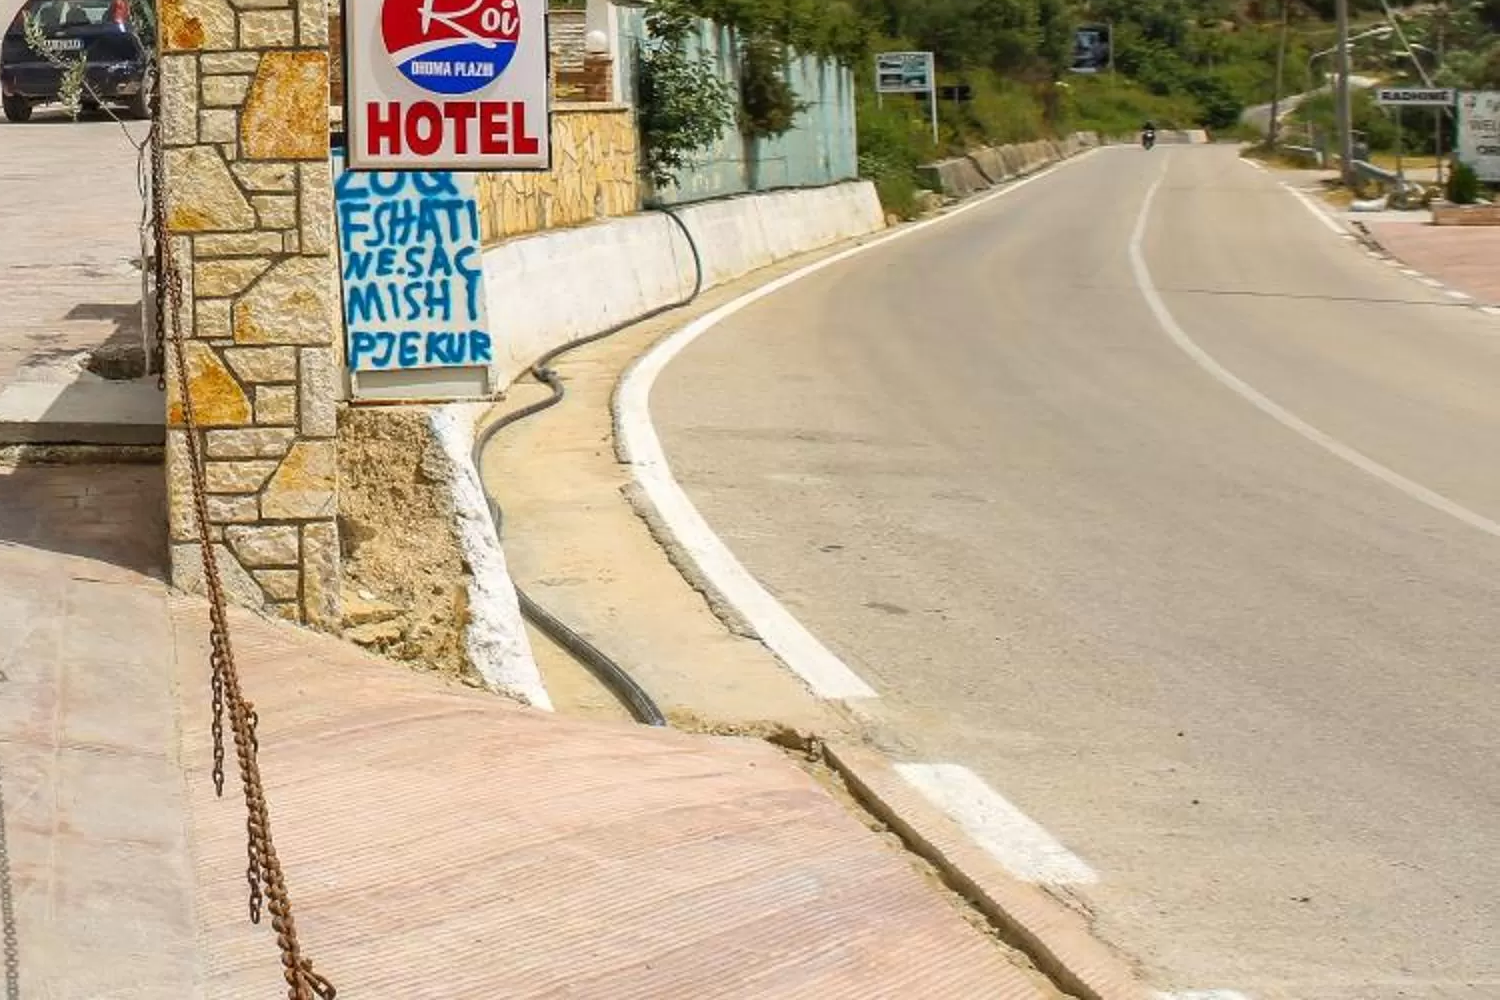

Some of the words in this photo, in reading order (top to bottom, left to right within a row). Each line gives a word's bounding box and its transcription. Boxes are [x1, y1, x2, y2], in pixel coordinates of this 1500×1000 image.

[367, 101, 539, 157] HOTEL
[339, 198, 479, 250] FSHATI
[348, 280, 450, 325] MISH
[350, 329, 492, 374] PJEKUR
